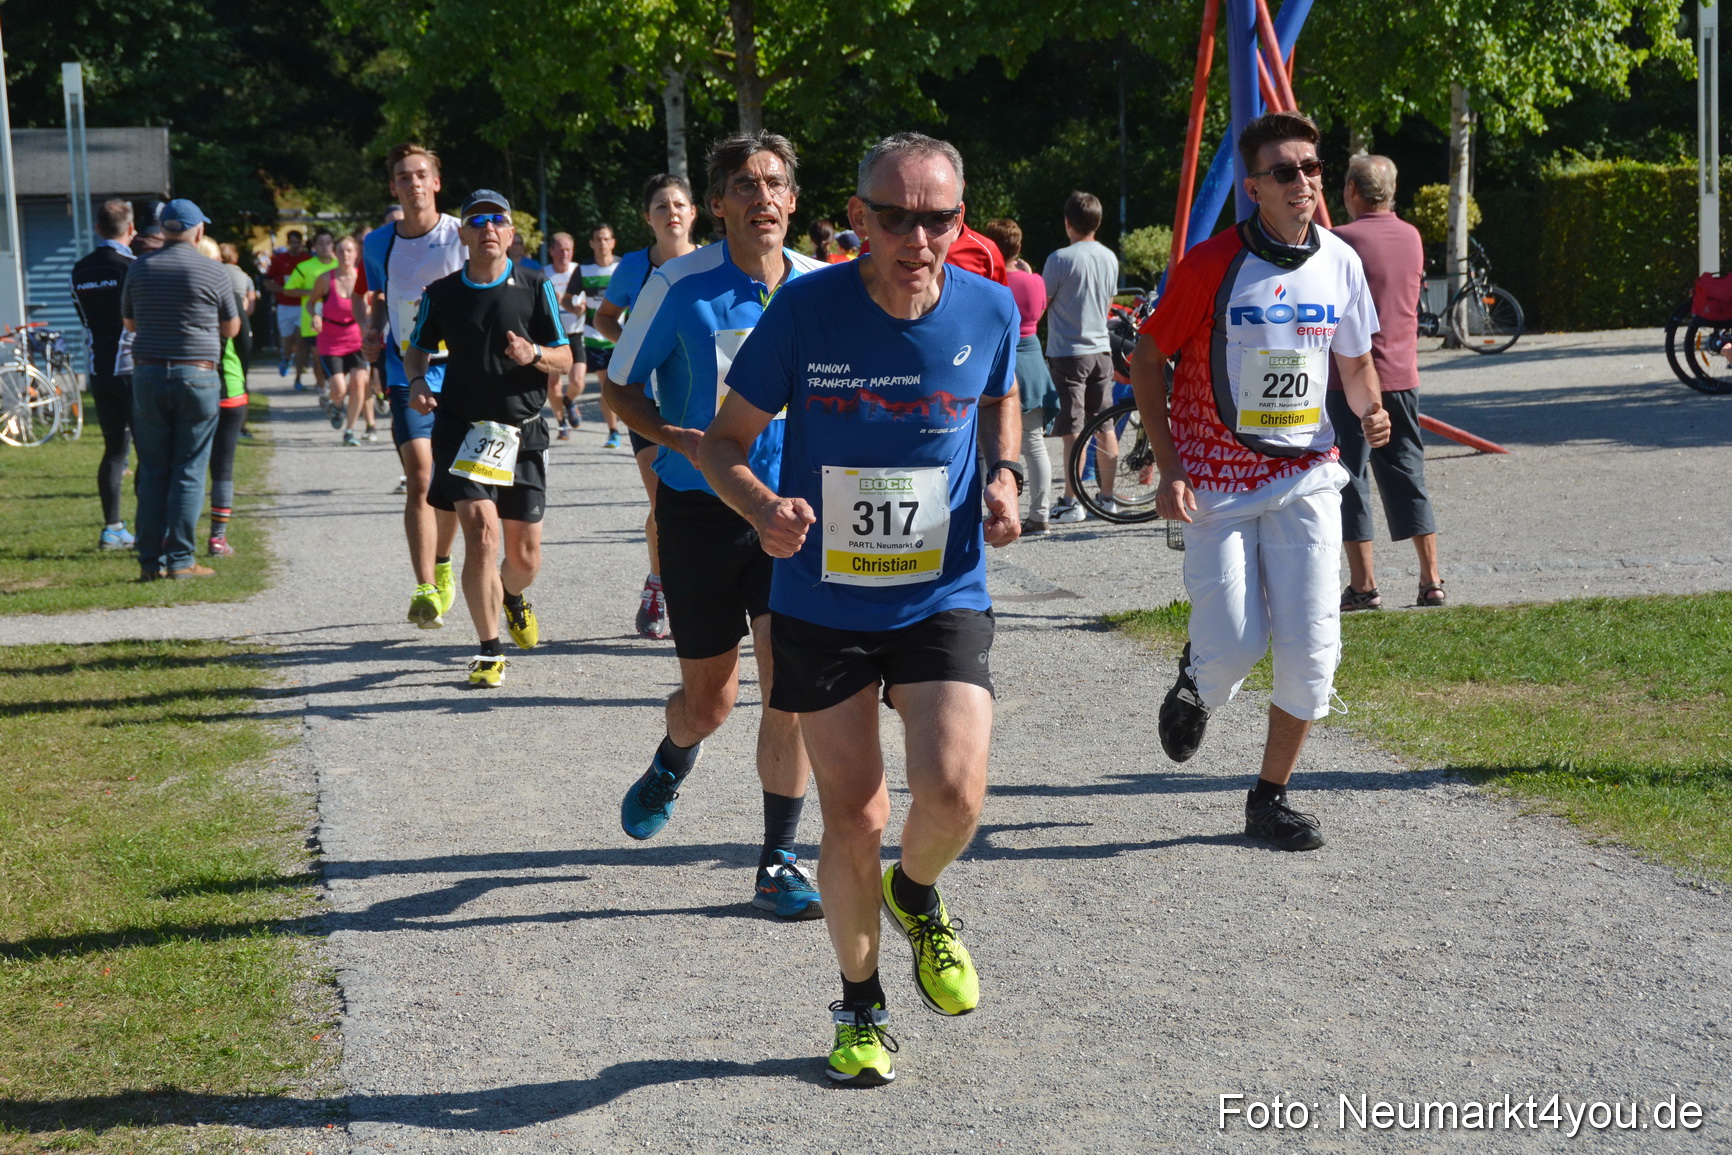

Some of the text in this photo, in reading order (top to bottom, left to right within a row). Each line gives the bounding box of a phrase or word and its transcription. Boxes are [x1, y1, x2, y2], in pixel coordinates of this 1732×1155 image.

[1296, 325, 1337, 337] energ
[1269, 356, 1307, 366] BOCK
[807, 363, 851, 374] MAINOVA
[807, 374, 921, 389] FRANKFURT MARATHON
[1262, 373, 1309, 399] 220
[1260, 413, 1305, 425] Christian
[474, 437, 506, 459] 312
[470, 463, 493, 477] Stefan
[1183, 458, 1214, 478] VIA
[859, 478, 914, 491] BOCK
[852, 501, 919, 536] 317
[848, 540, 913, 550] PARTL Neumarkt
[852, 556, 917, 572] Christian
